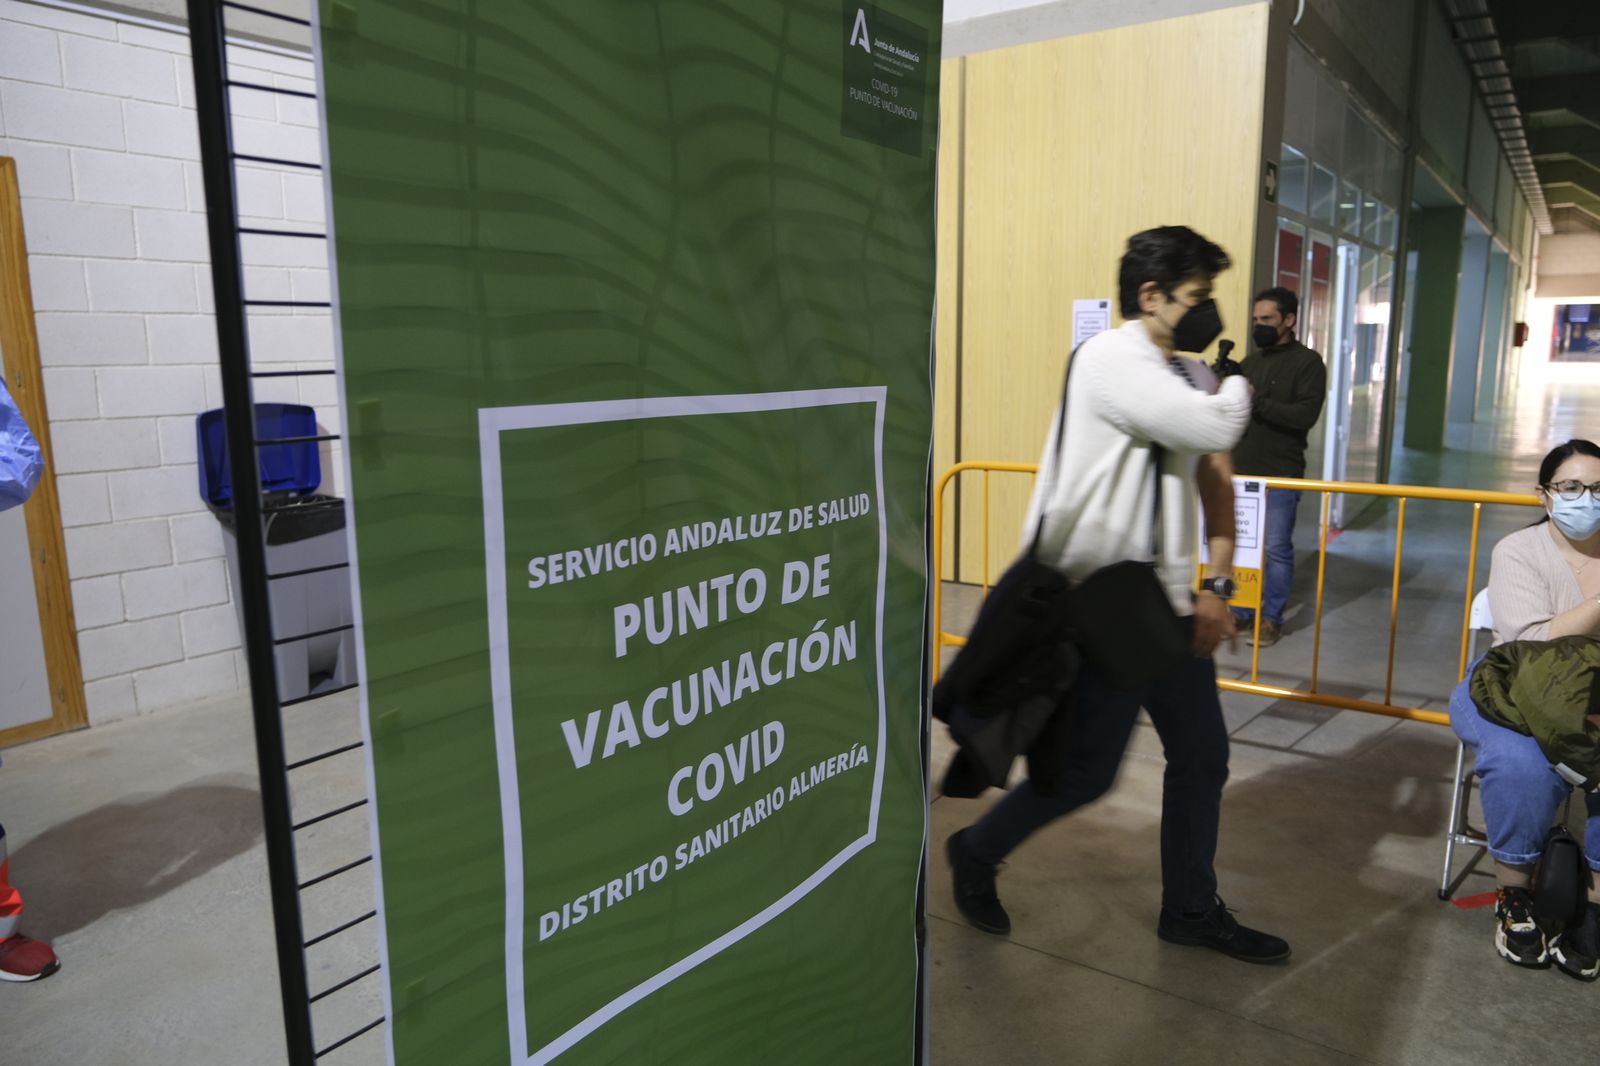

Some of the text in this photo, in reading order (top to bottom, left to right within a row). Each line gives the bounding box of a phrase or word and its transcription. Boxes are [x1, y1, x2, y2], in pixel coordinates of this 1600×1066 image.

[849, 87, 918, 120] PUNTO DE VACUNACIÓN
[871, 78, 898, 97] COVID-19
[528, 492, 870, 589] SERVICIO ANDALUZ DE SALUD
[613, 553, 831, 658] PUNTO DE
[560, 618, 857, 769] VACUNACIÓN
[667, 720, 785, 817] COVID
[539, 742, 869, 942] DISTRITO SANITARIO ALMERÍA
